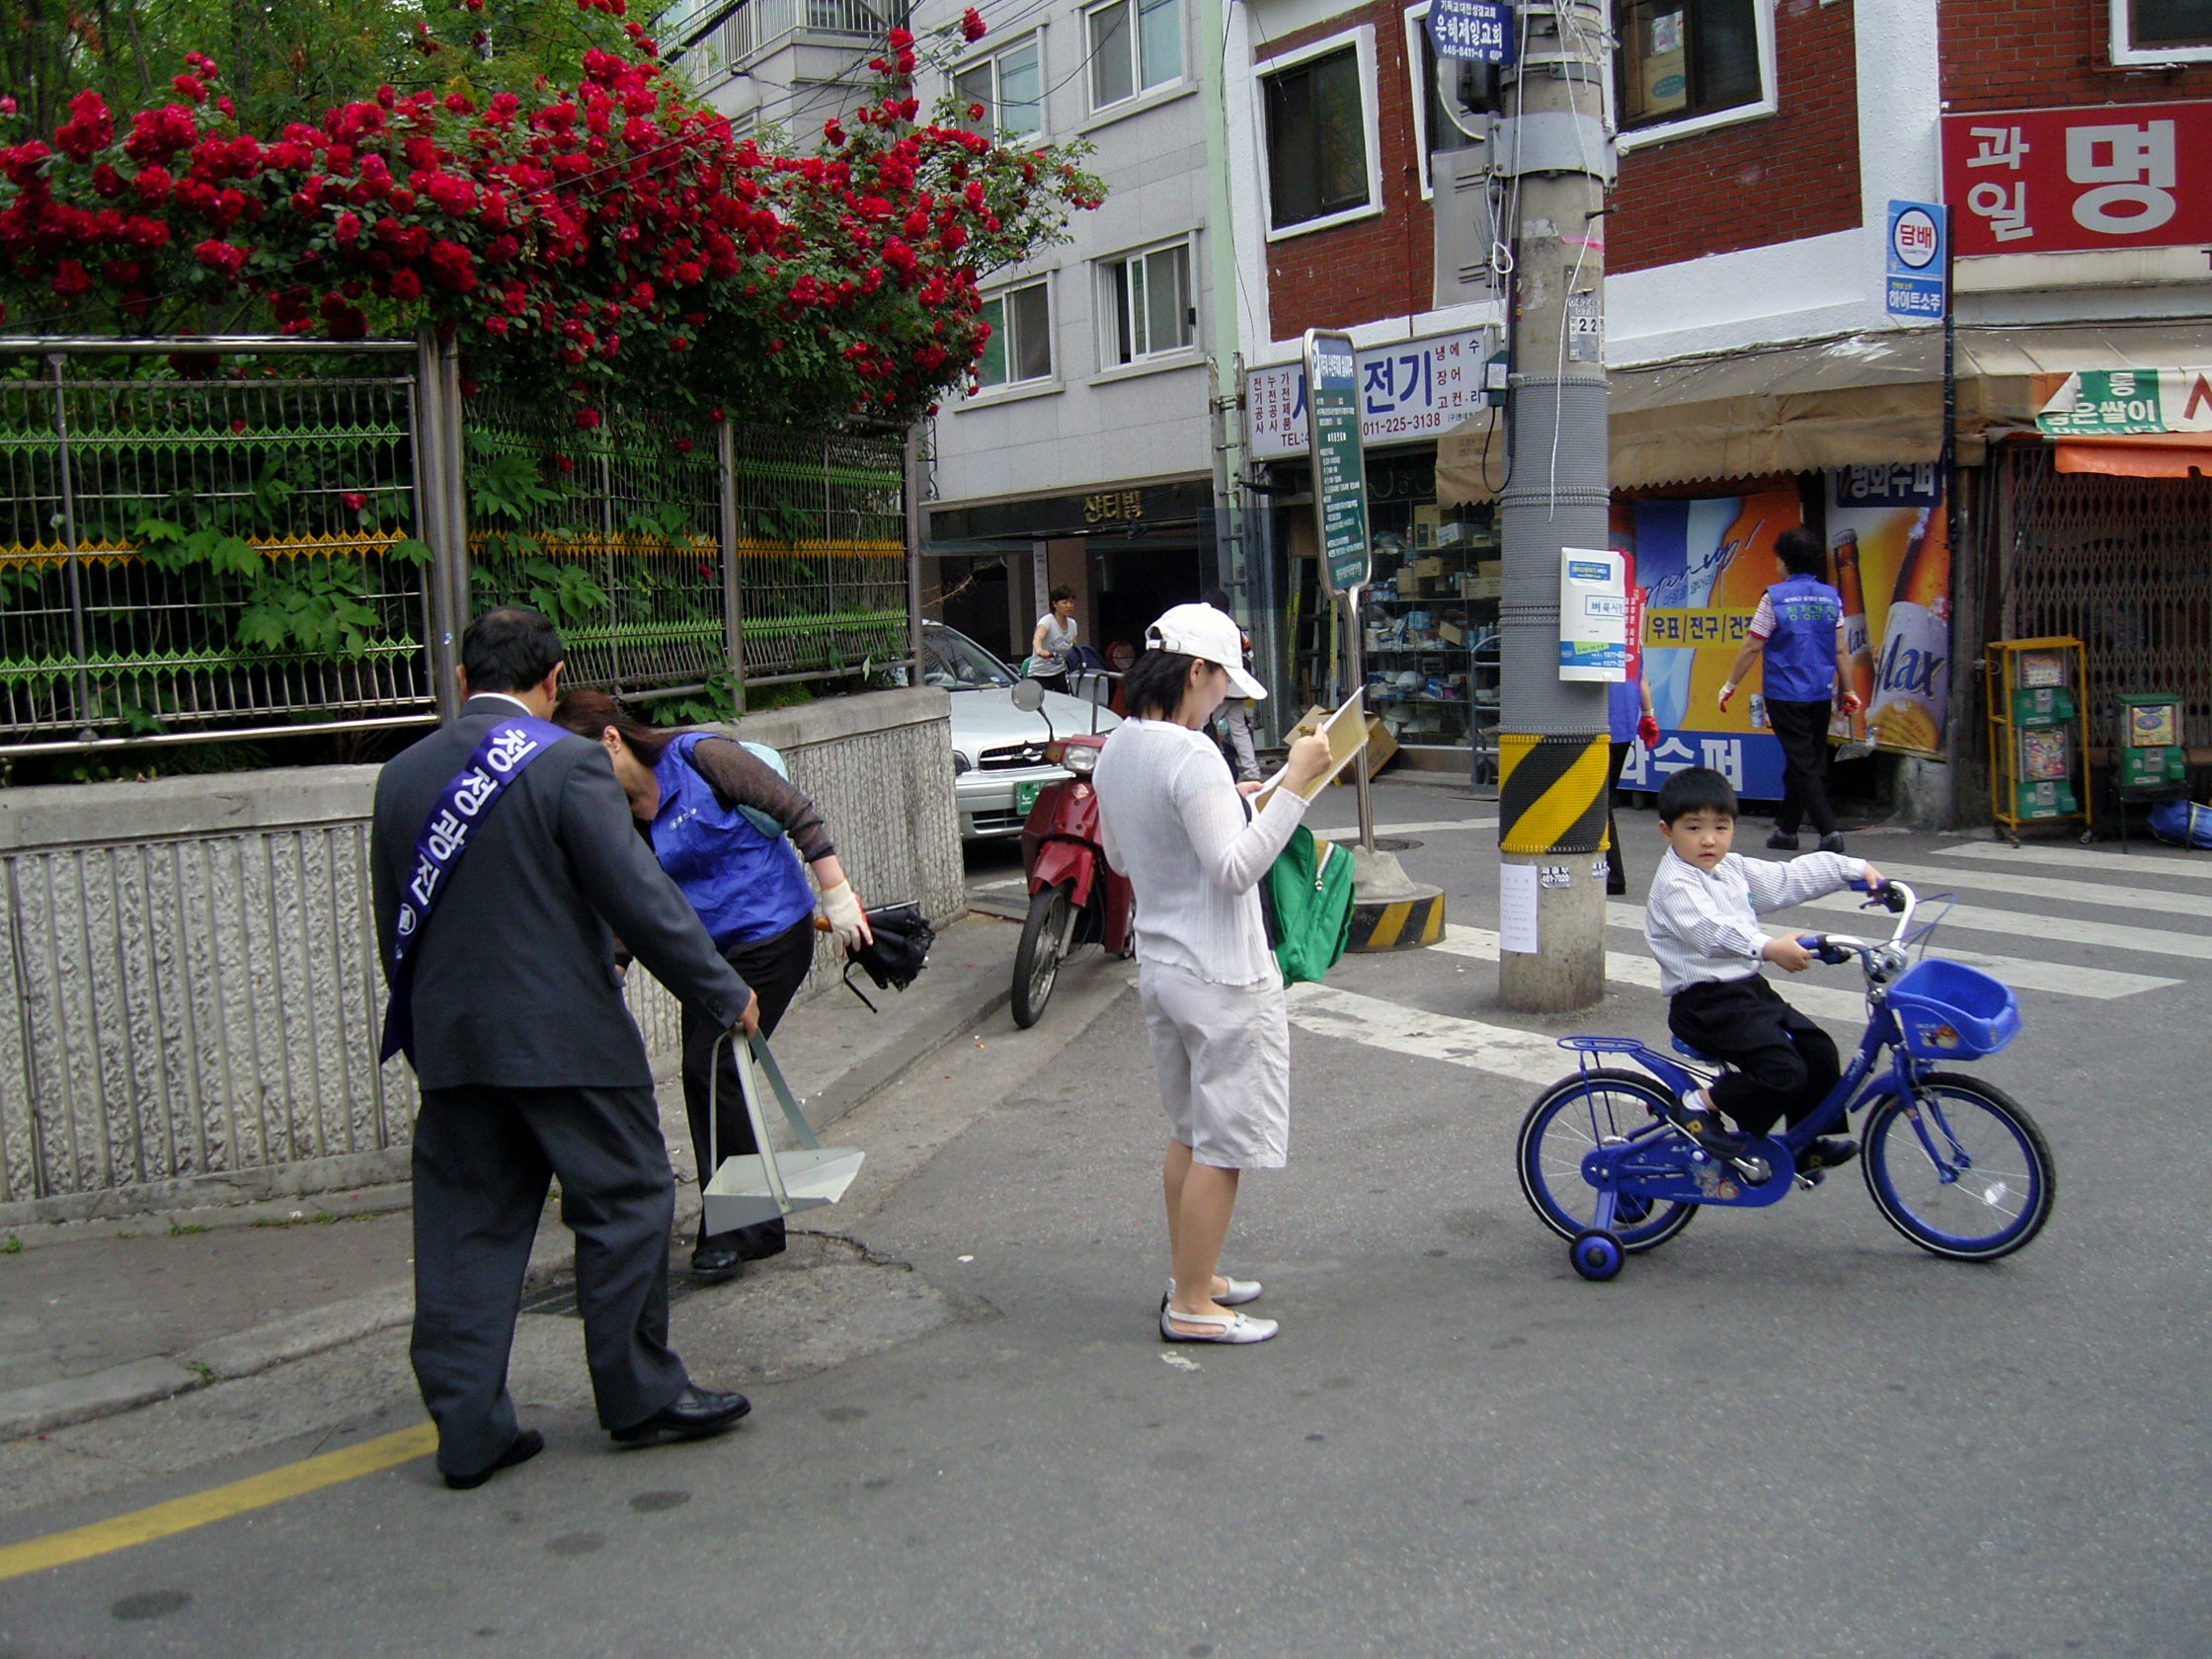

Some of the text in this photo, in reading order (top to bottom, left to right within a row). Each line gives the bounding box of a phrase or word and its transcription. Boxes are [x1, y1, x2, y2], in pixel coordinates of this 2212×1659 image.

[1435, 14, 1502, 49] 은혜제일교회
[1966, 126, 2033, 243] 과일
[2066, 119, 2176, 234] 명
[1900, 224, 1932, 248] 담배
[1889, 290, 1940, 312] 하이트소주
[1253, 376, 1264, 434] 전기공사
[1267, 375, 1278, 433] 누전공사
[1281, 371, 1292, 432] 가전제품
[1363, 412, 1441, 435] 011-225-3138
[1652, 616, 1680, 640] 우표
[1690, 616, 1718, 640] 전구
[410, 729, 538, 907] 청정광진
